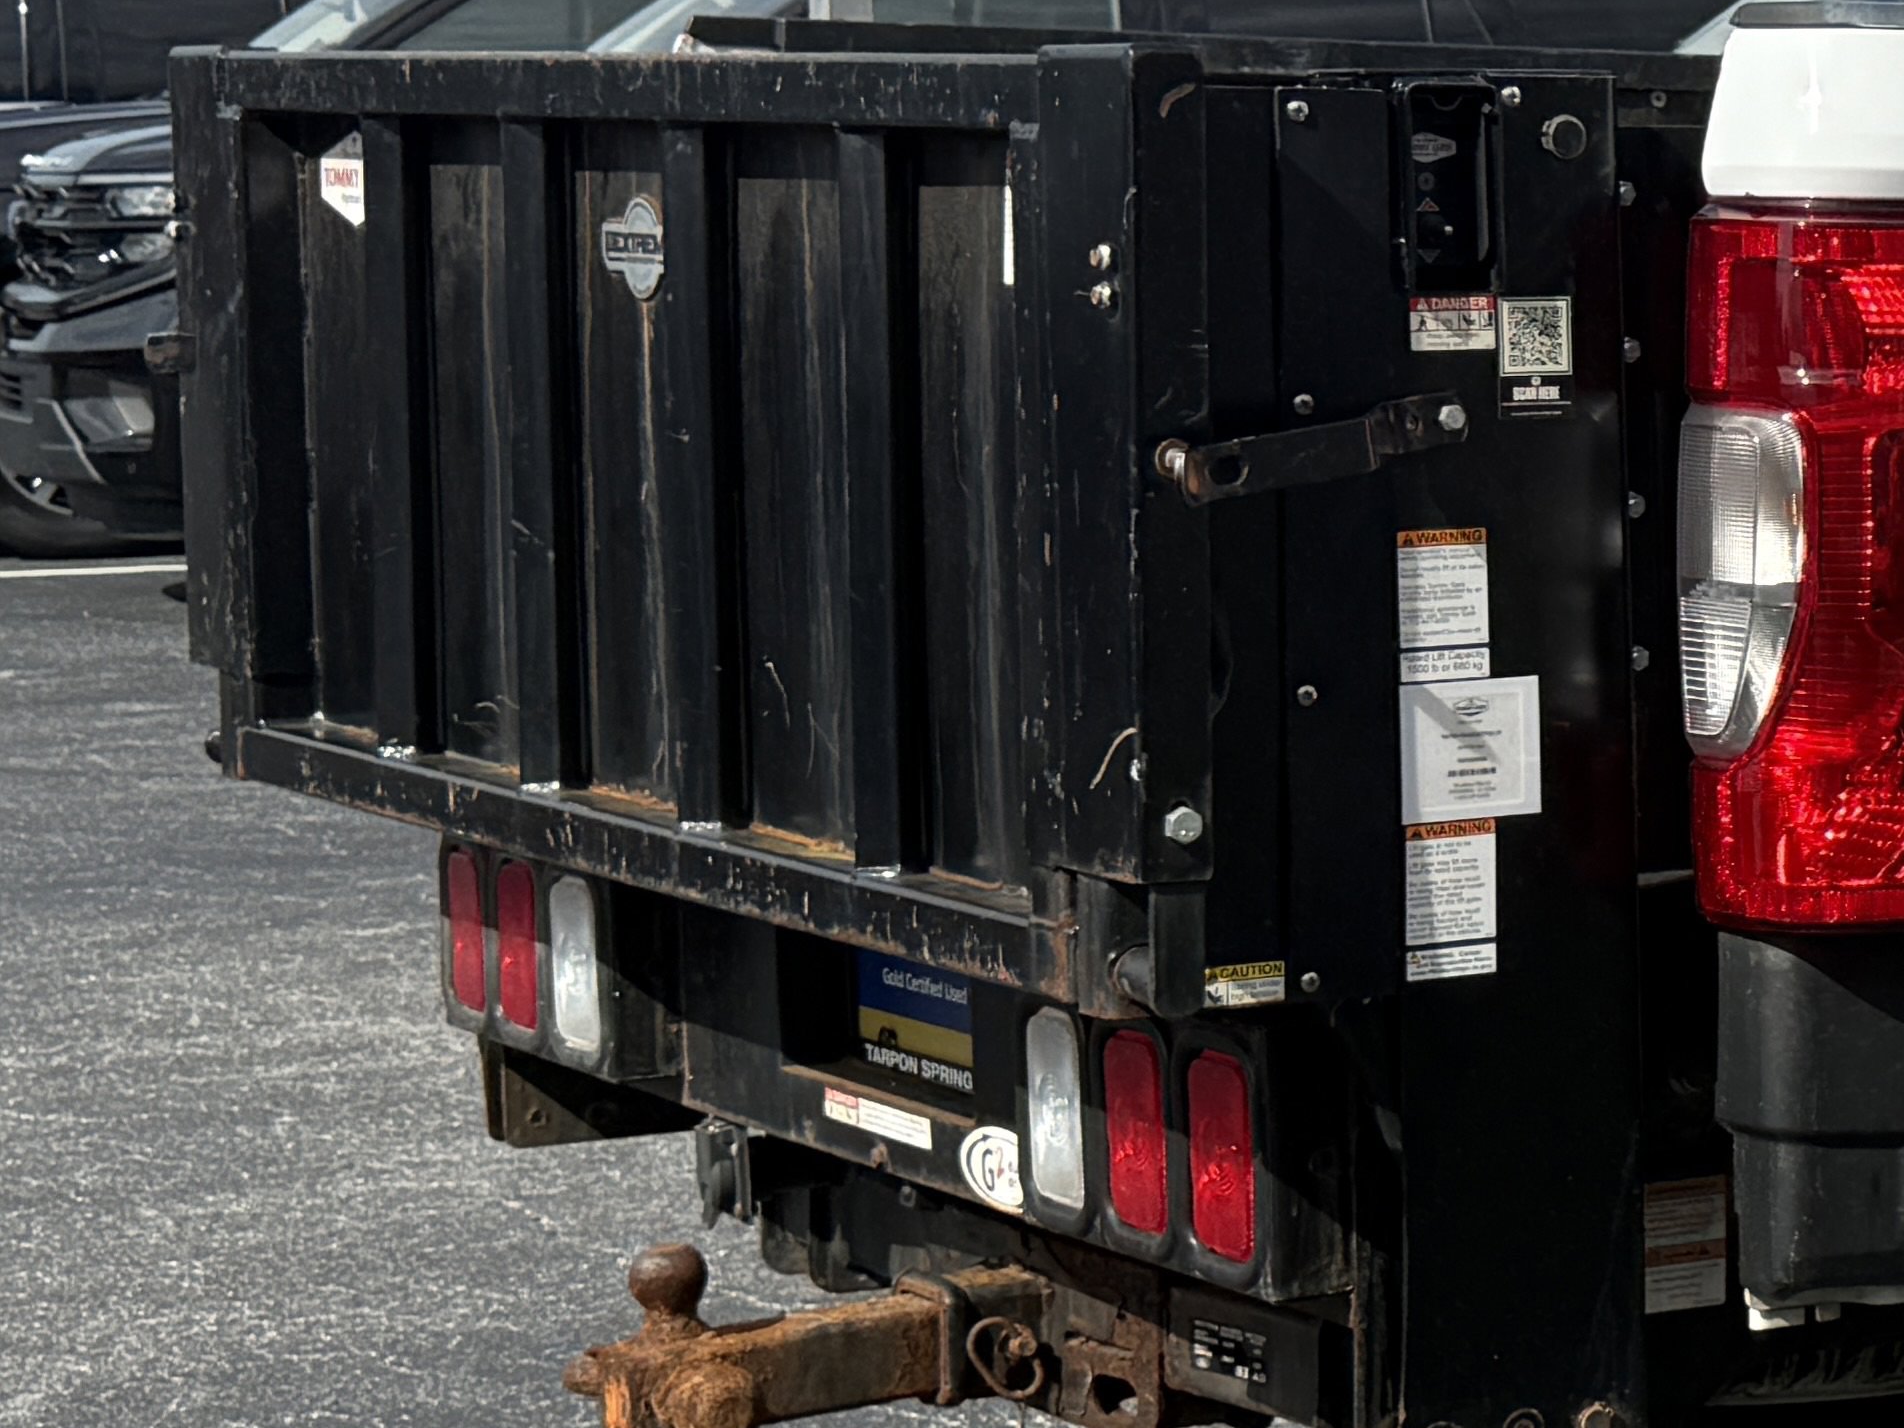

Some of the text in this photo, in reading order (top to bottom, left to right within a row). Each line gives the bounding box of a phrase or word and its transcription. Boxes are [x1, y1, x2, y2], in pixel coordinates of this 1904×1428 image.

[323, 167, 360, 188] TOMMY
[1431, 296, 1489, 311] DANGER
[1512, 385, 1561, 401] SCAN HERE
[1416, 529, 1483, 544] WARNING
[1424, 819, 1492, 837] WARNING
[1219, 963, 1282, 978] CAUTION
[882, 967, 968, 1005] Gold Certified Used
[864, 1042, 919, 1075] TARPON
